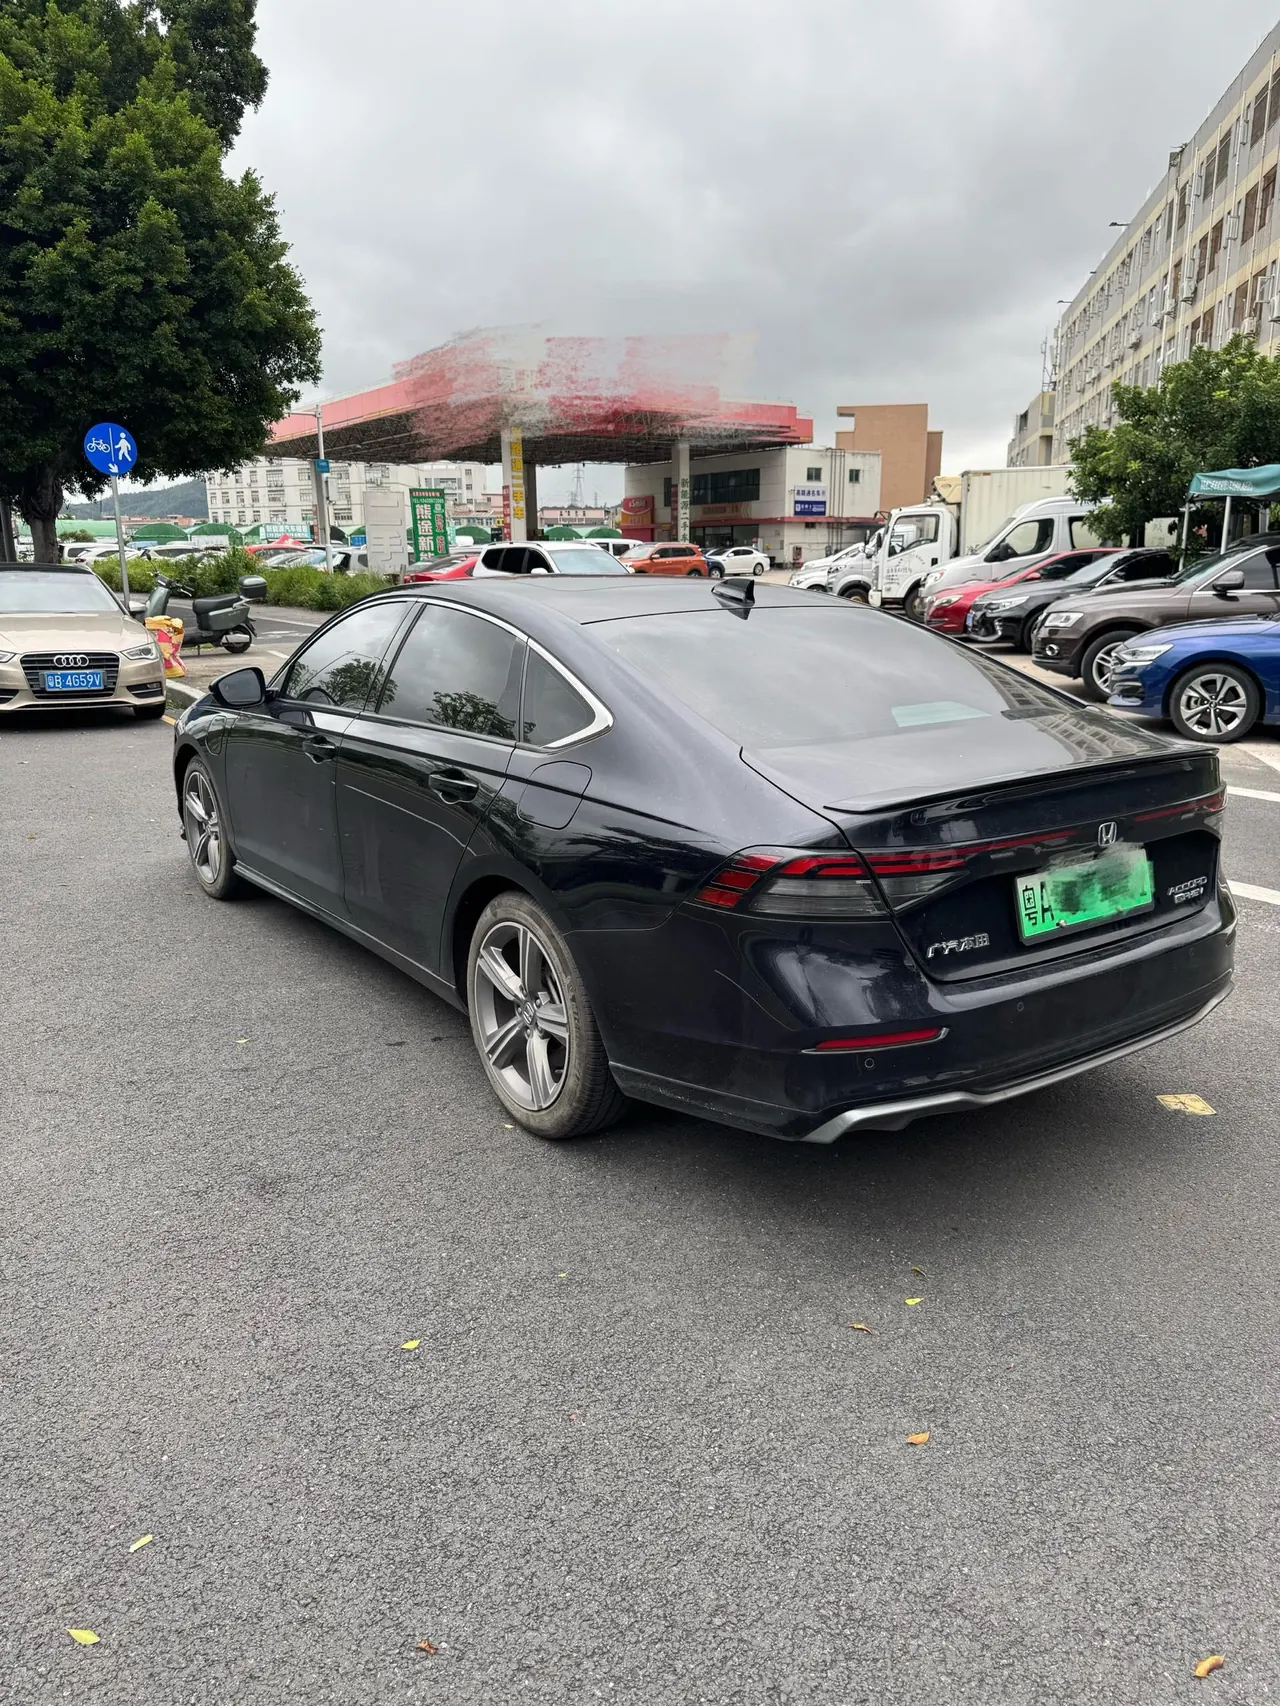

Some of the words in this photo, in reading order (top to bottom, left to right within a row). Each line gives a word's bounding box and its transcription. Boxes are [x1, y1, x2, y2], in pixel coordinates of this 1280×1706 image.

[680, 478, 689, 542] 新能源二手车
[1167, 876, 1208, 896] ACCORD
[927, 933, 990, 958] 广汽本田
